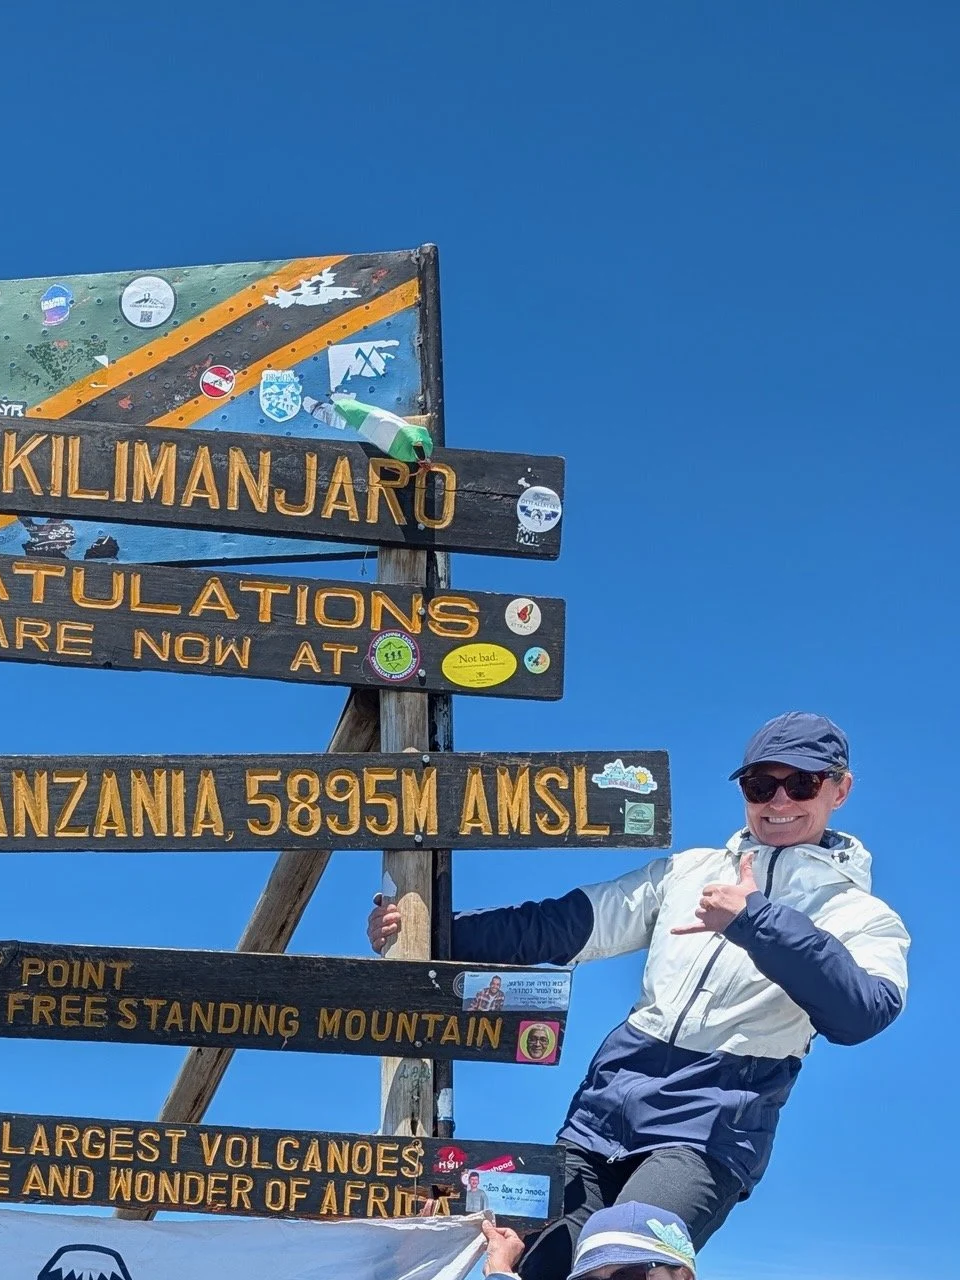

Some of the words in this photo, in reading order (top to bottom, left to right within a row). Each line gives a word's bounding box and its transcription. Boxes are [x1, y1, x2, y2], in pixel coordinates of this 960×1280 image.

[1, 430, 456, 529] KILIMANJARO
[133, 628, 251, 669] NOW
[290, 641, 358, 675] AT
[459, 655, 477, 664] Not
[245, 766, 438, 837] 5895M
[459, 764, 610, 837] AMSL
[21, 957, 133, 990] POINT
[7, 992, 108, 1028] FREE
[117, 998, 300, 1037] STANDING
[318, 1007, 503, 1049] MOUNTAIN
[1, 1120, 187, 1164] LARGEST
[200, 1133, 424, 1178] VOLCANOES
[22, 1163, 94, 1199] AND
[109, 1165, 253, 1209] WONDER
[265, 1178, 311, 1212] OF
